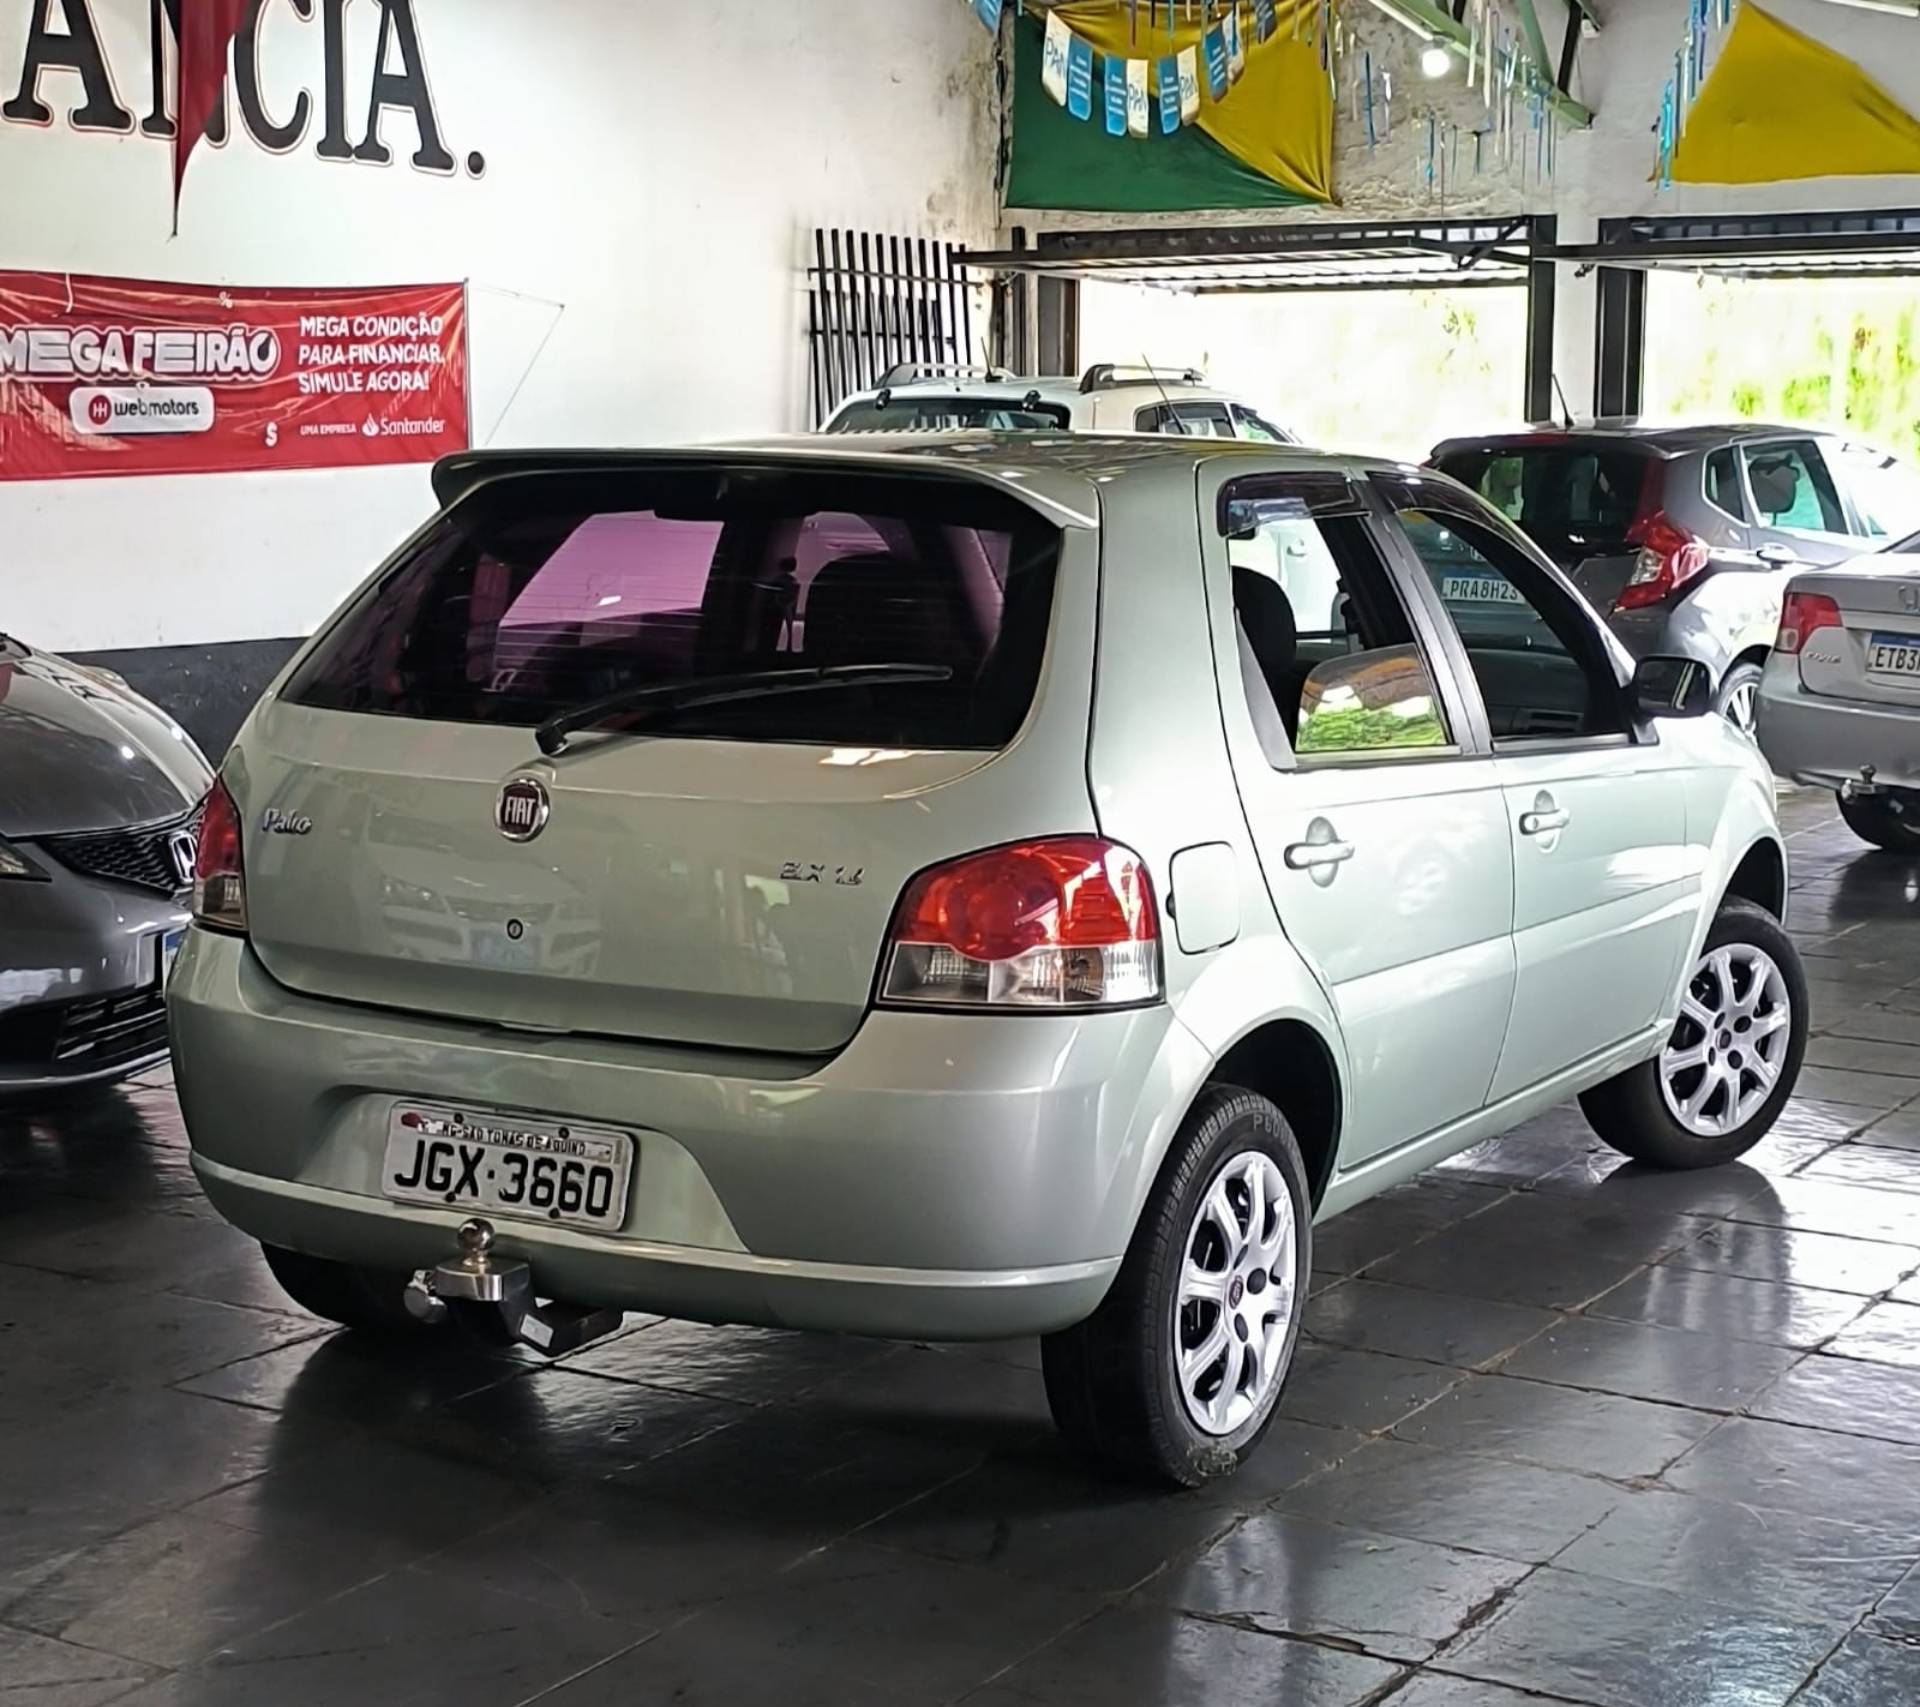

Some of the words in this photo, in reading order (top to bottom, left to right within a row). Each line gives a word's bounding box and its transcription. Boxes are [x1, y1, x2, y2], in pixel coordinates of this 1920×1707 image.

[300, 316, 350, 337] MEGA
[353, 312, 444, 341] CONDIÇÃO
[0, 330, 129, 374] MEGA
[132, 327, 278, 376] FEIRÃO
[299, 344, 345, 365] PARA
[299, 371, 363, 393] SIMULE
[366, 371, 430, 392] AGORA!
[114, 400, 200, 418] webmotors
[301, 424, 318, 435] UMA
[320, 423, 357, 435] EMPRESA
[381, 416, 445, 435] Santander
[1875, 646, 1920, 671] ETB3
[262, 808, 312, 834] Palio
[504, 796, 536, 825] FIAT
